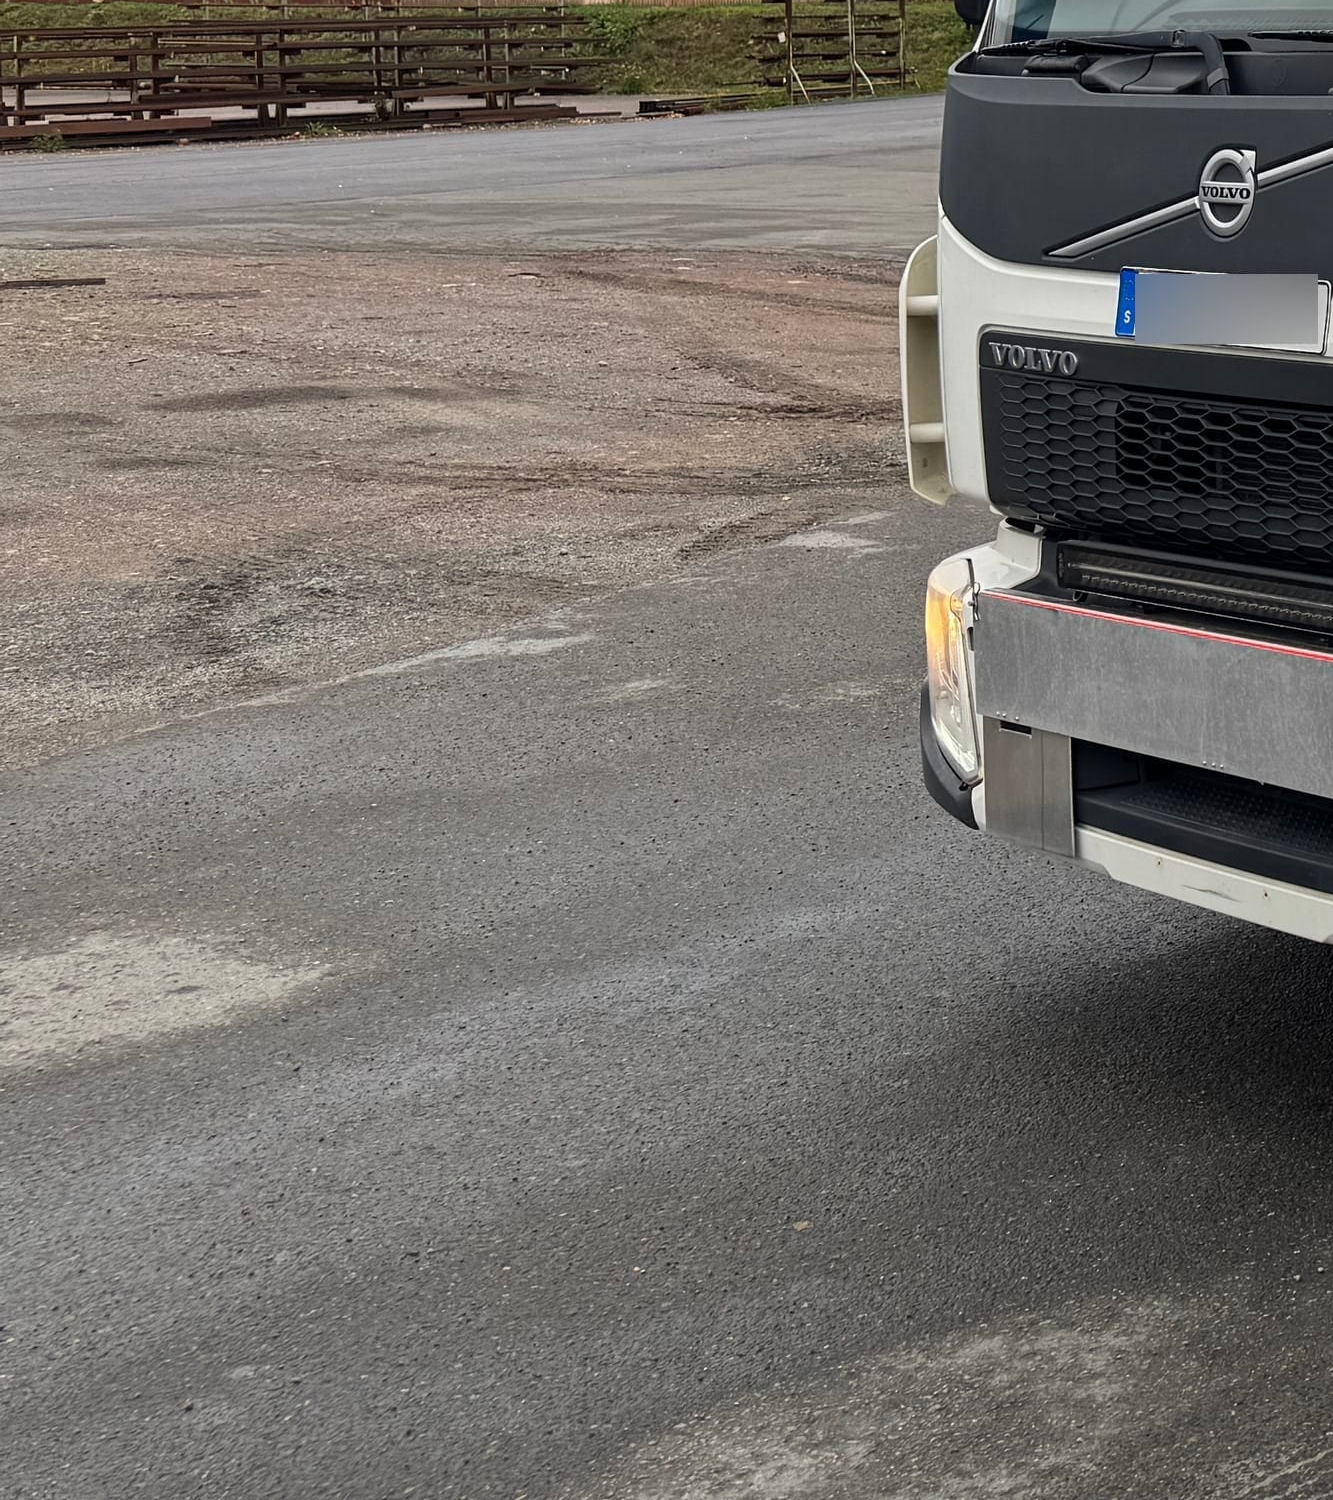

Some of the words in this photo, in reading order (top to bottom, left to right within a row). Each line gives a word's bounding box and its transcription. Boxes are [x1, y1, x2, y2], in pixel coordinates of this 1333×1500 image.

[1201, 186, 1251, 199] VOLVO
[1123, 310, 1131, 324] S
[988, 341, 1079, 376] VOLVO
